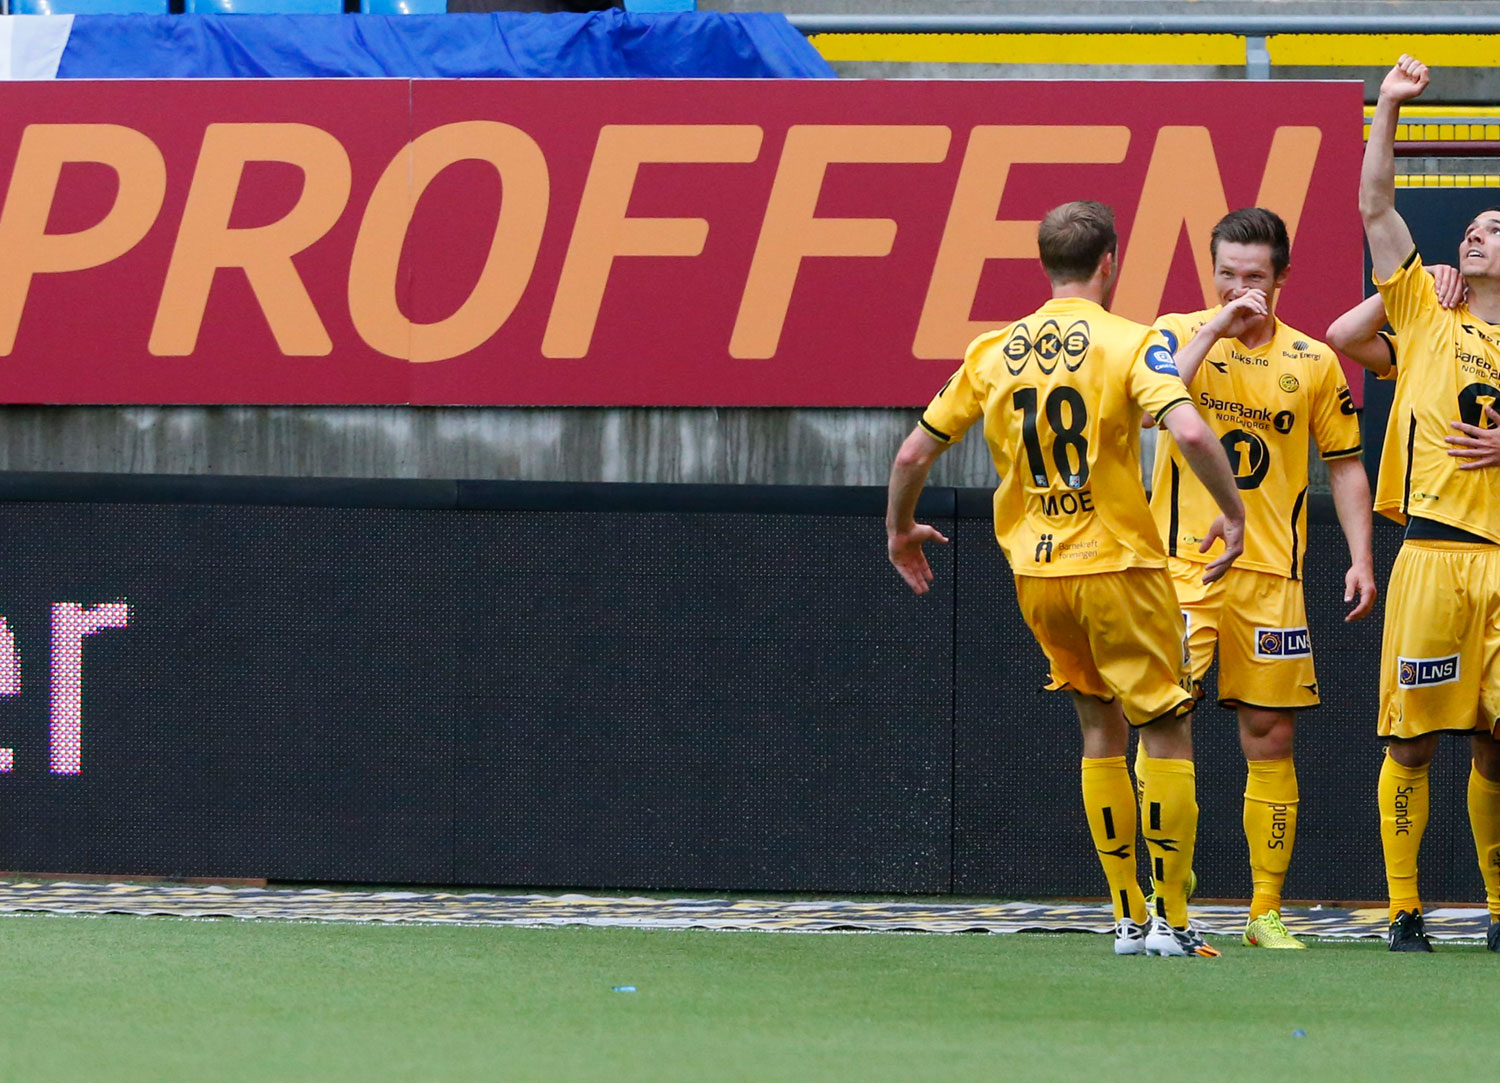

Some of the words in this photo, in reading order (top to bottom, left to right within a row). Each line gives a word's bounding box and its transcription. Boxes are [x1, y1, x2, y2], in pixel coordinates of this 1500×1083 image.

[0, 119, 1323, 363] PROFFEN
[1231, 350, 1269, 367] laks.no
[1200, 392, 1272, 422] SpareBank
[1012, 386, 1090, 488] 18
[1040, 490, 1095, 516] MOE
[1422, 662, 1453, 680] LNS
[1395, 785, 1414, 836] Scandic
